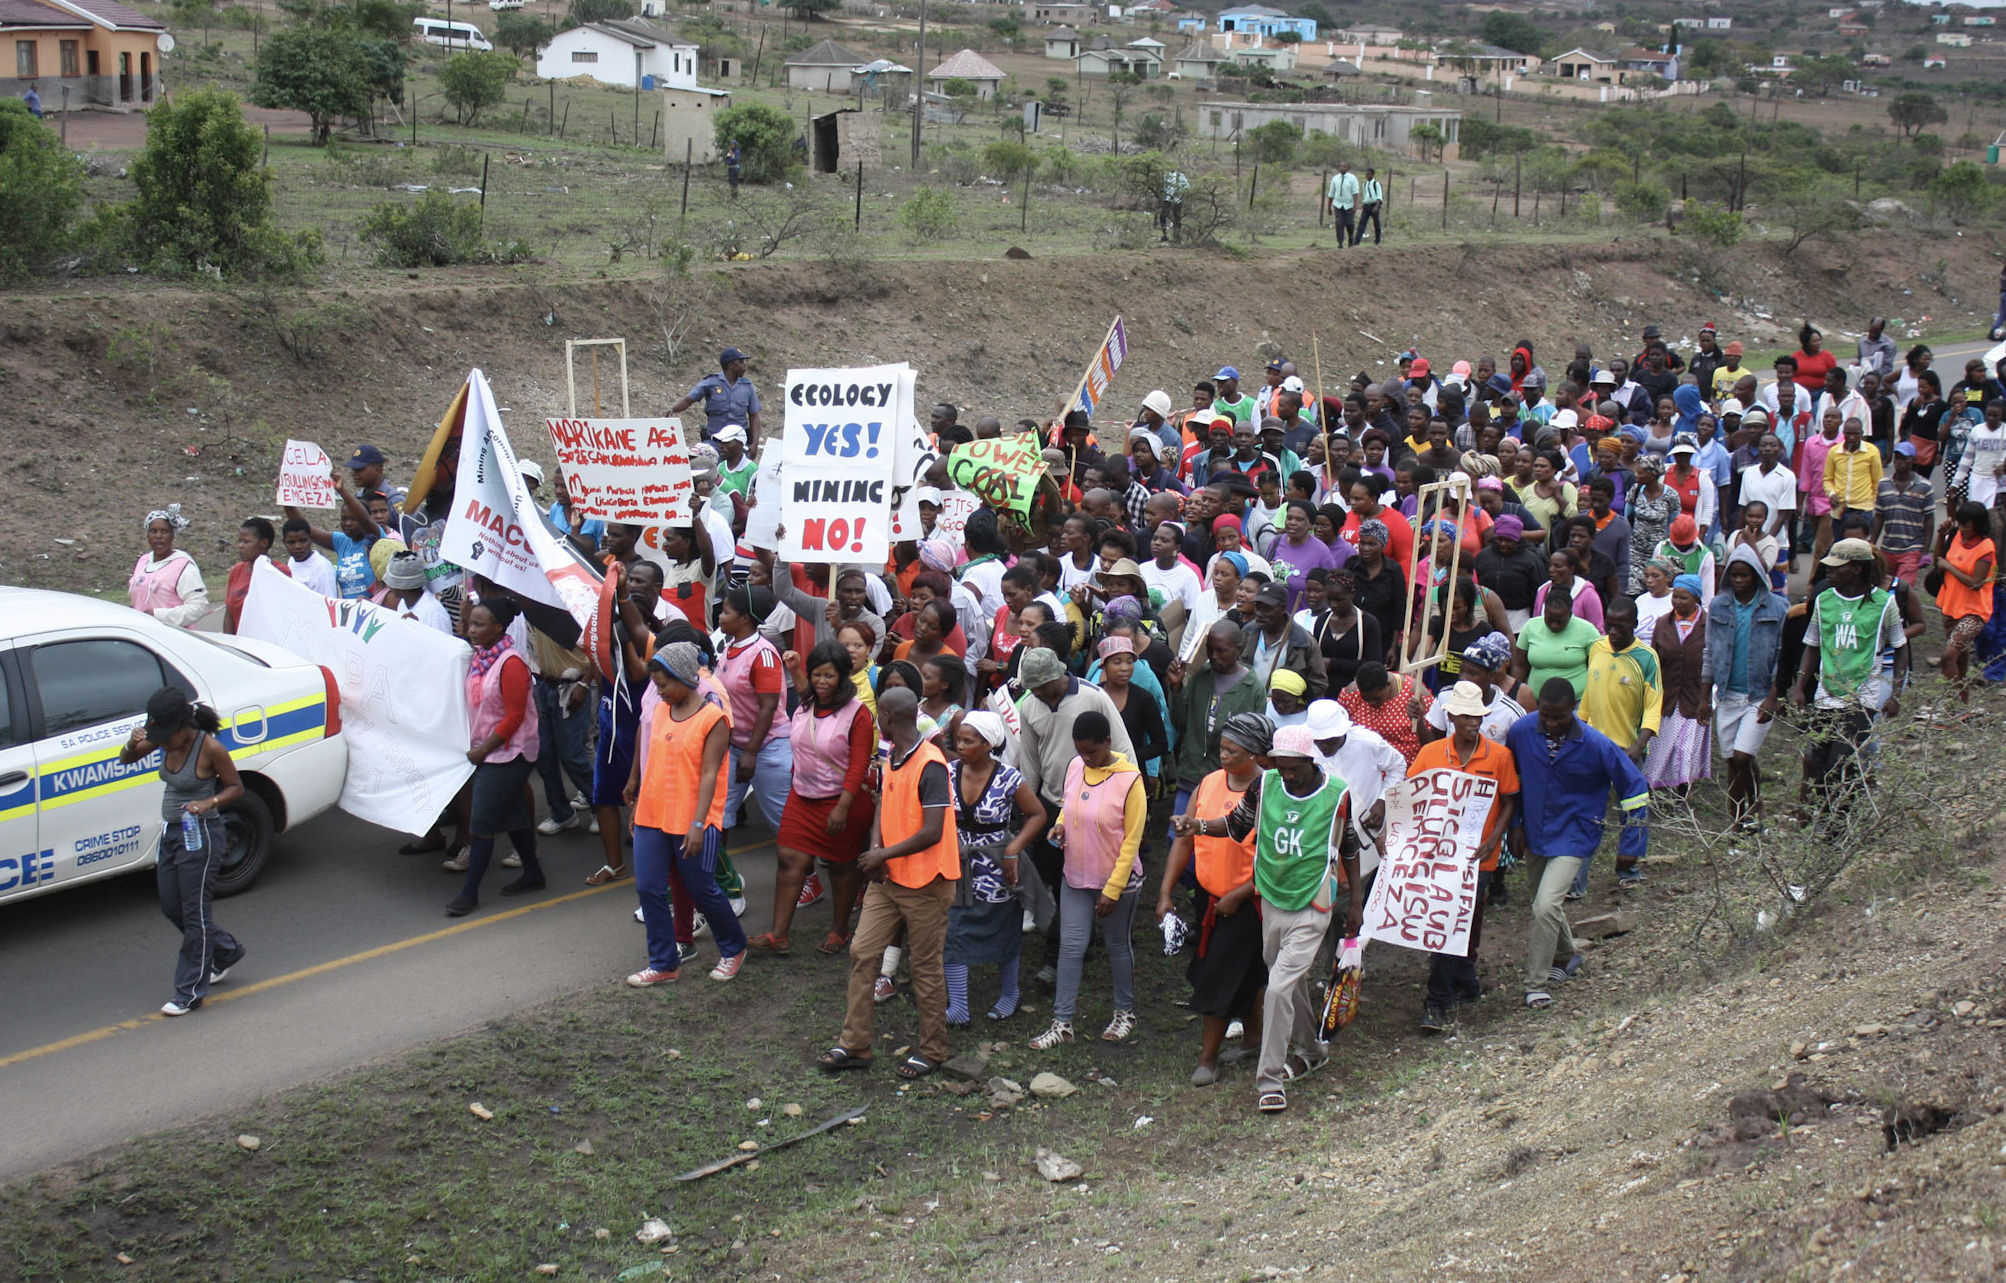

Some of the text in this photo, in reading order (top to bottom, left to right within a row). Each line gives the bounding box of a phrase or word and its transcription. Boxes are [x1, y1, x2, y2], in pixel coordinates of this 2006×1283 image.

[790, 383, 893, 408] ECOLOGY
[802, 422, 882, 459] YES!
[477, 447, 487, 484] Mining
[793, 480, 884, 504] MINING
[478, 531, 539, 568] Nothing about us
[802, 517, 866, 553] NO!
[487, 546, 527, 573] without us!
[1835, 624, 1858, 649] WA
[61, 719, 148, 749] SA POLICE SERVIC
[53, 749, 162, 792] KWAMSANE
[75, 825, 141, 852] CRIME STOP
[77, 840, 139, 866] 0860010111
[1274, 826, 1305, 857] GK
[1452, 895, 1474, 935] FALL
